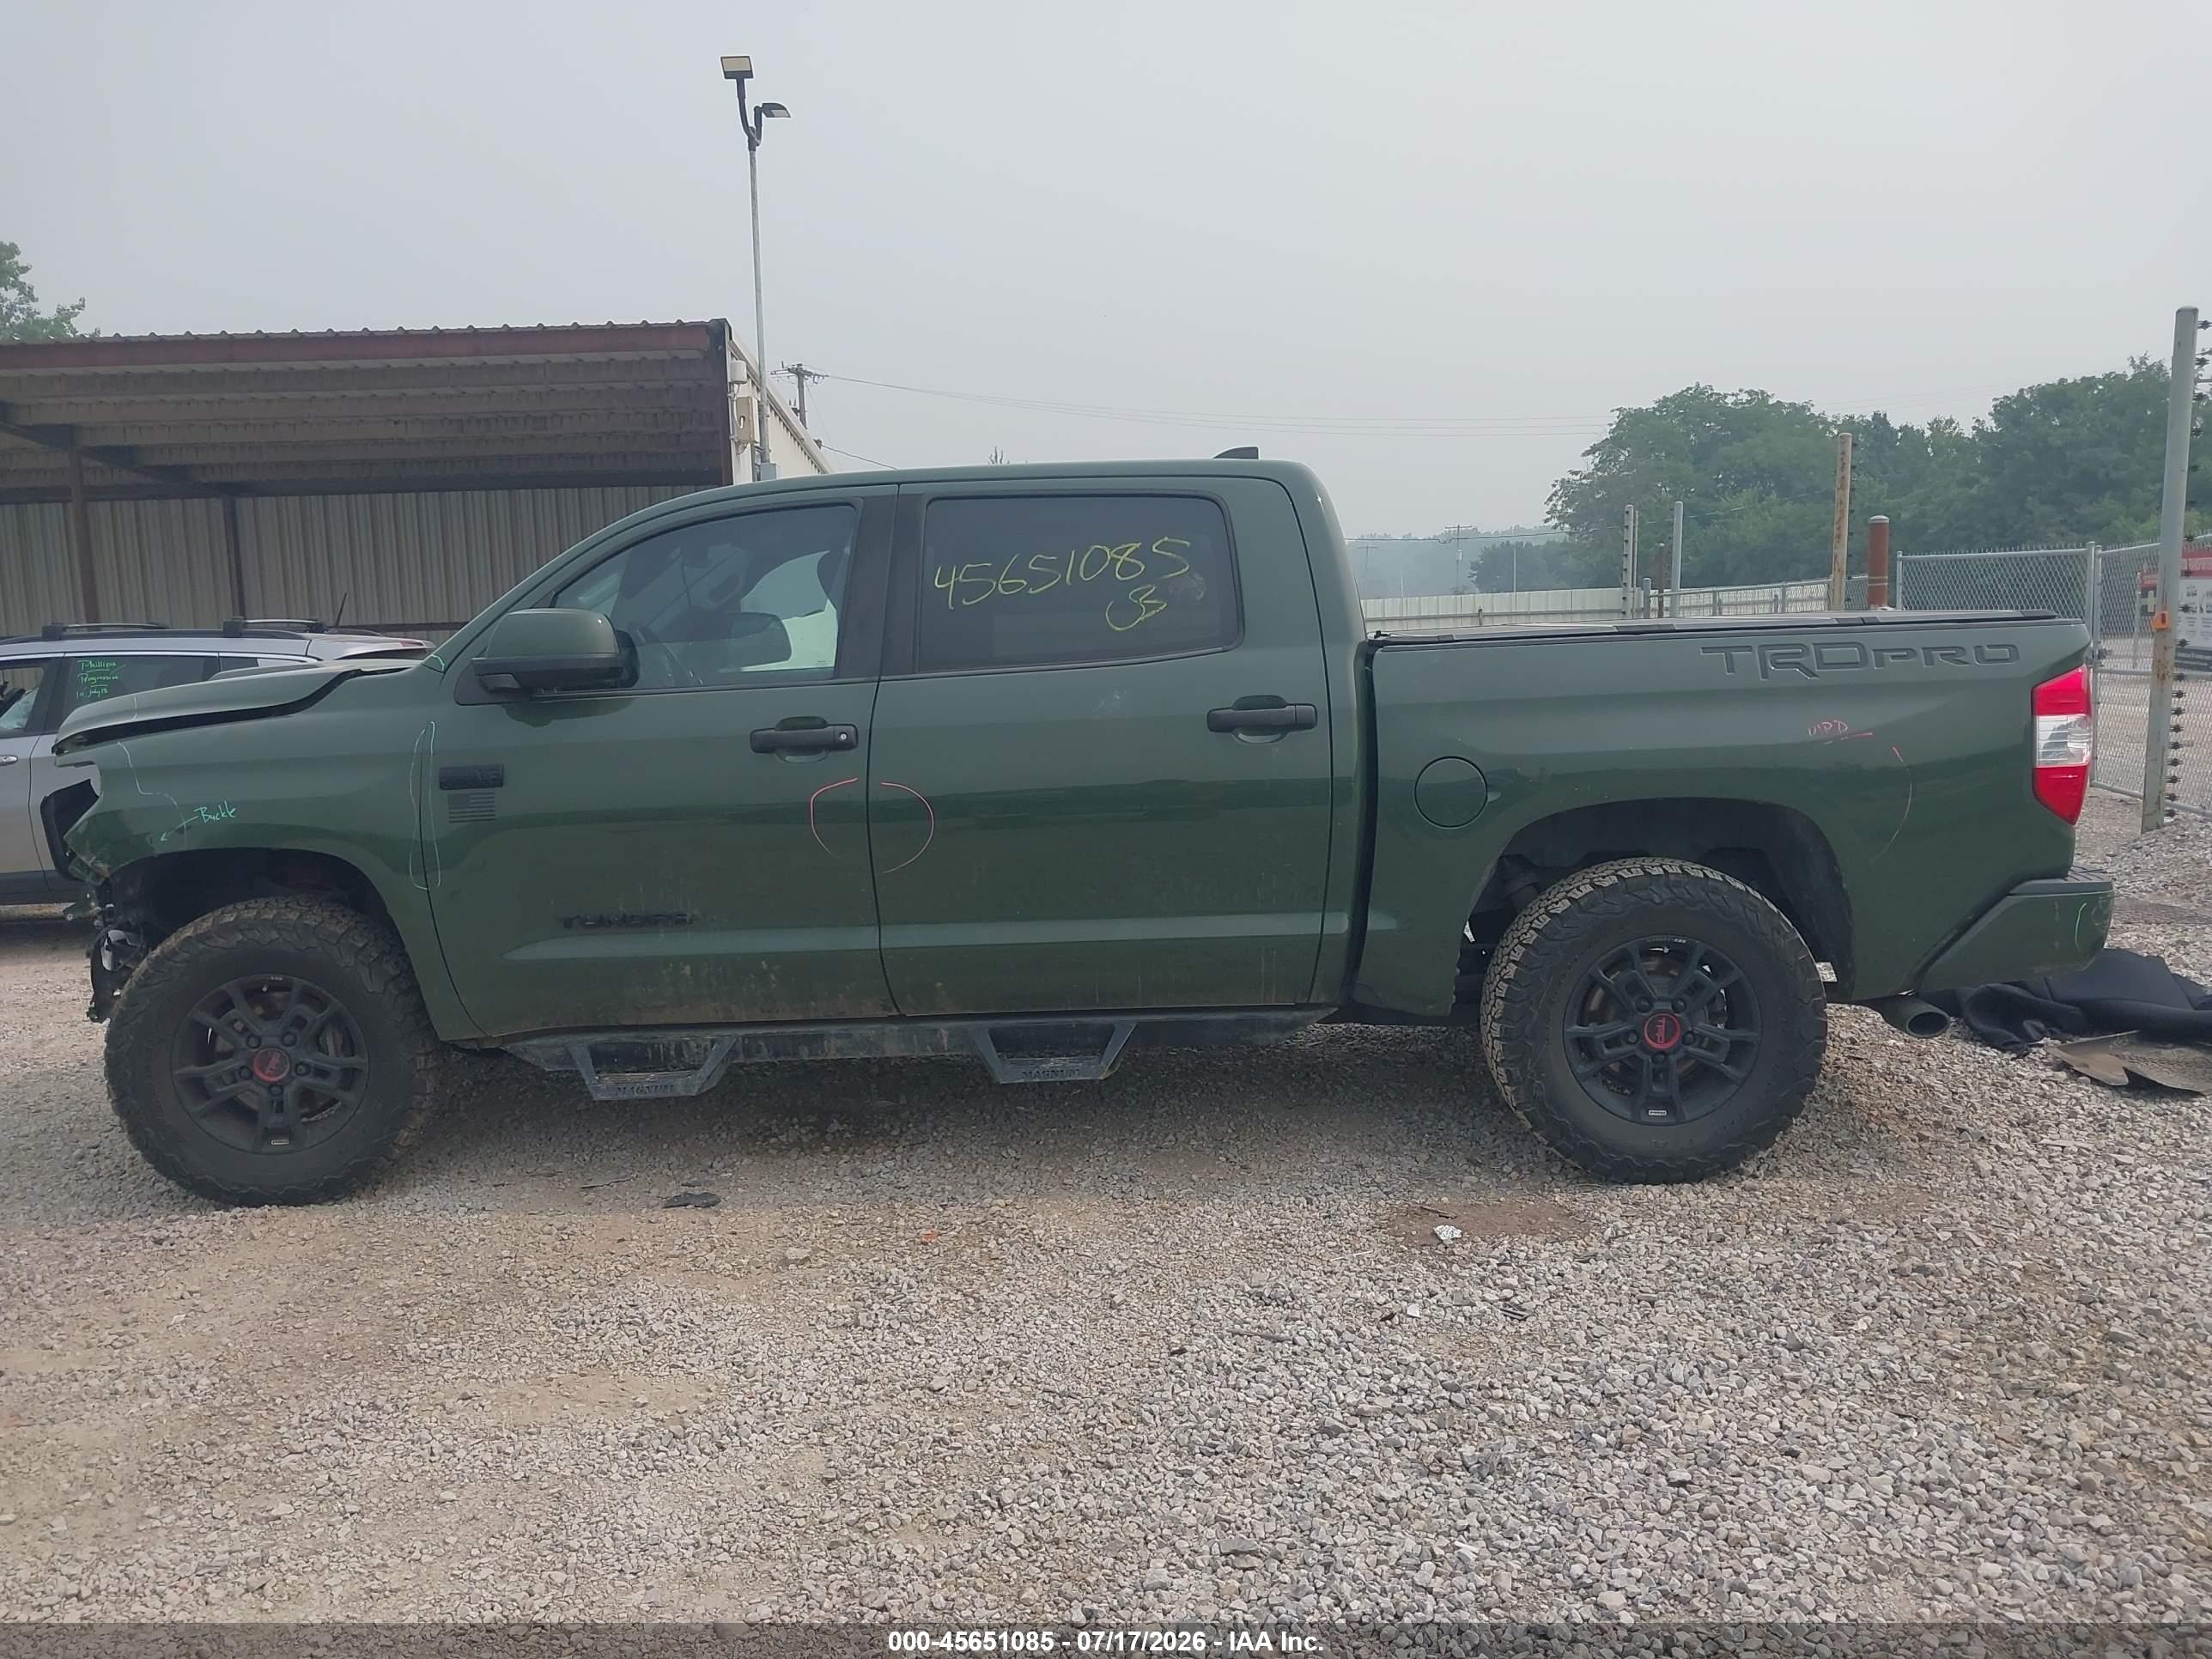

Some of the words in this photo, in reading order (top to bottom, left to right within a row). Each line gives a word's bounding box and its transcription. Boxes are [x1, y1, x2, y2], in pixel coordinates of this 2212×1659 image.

[934, 536, 1191, 610] 45651085
[1699, 641, 1869, 681] TRD
[1872, 643, 2021, 670] PRO
